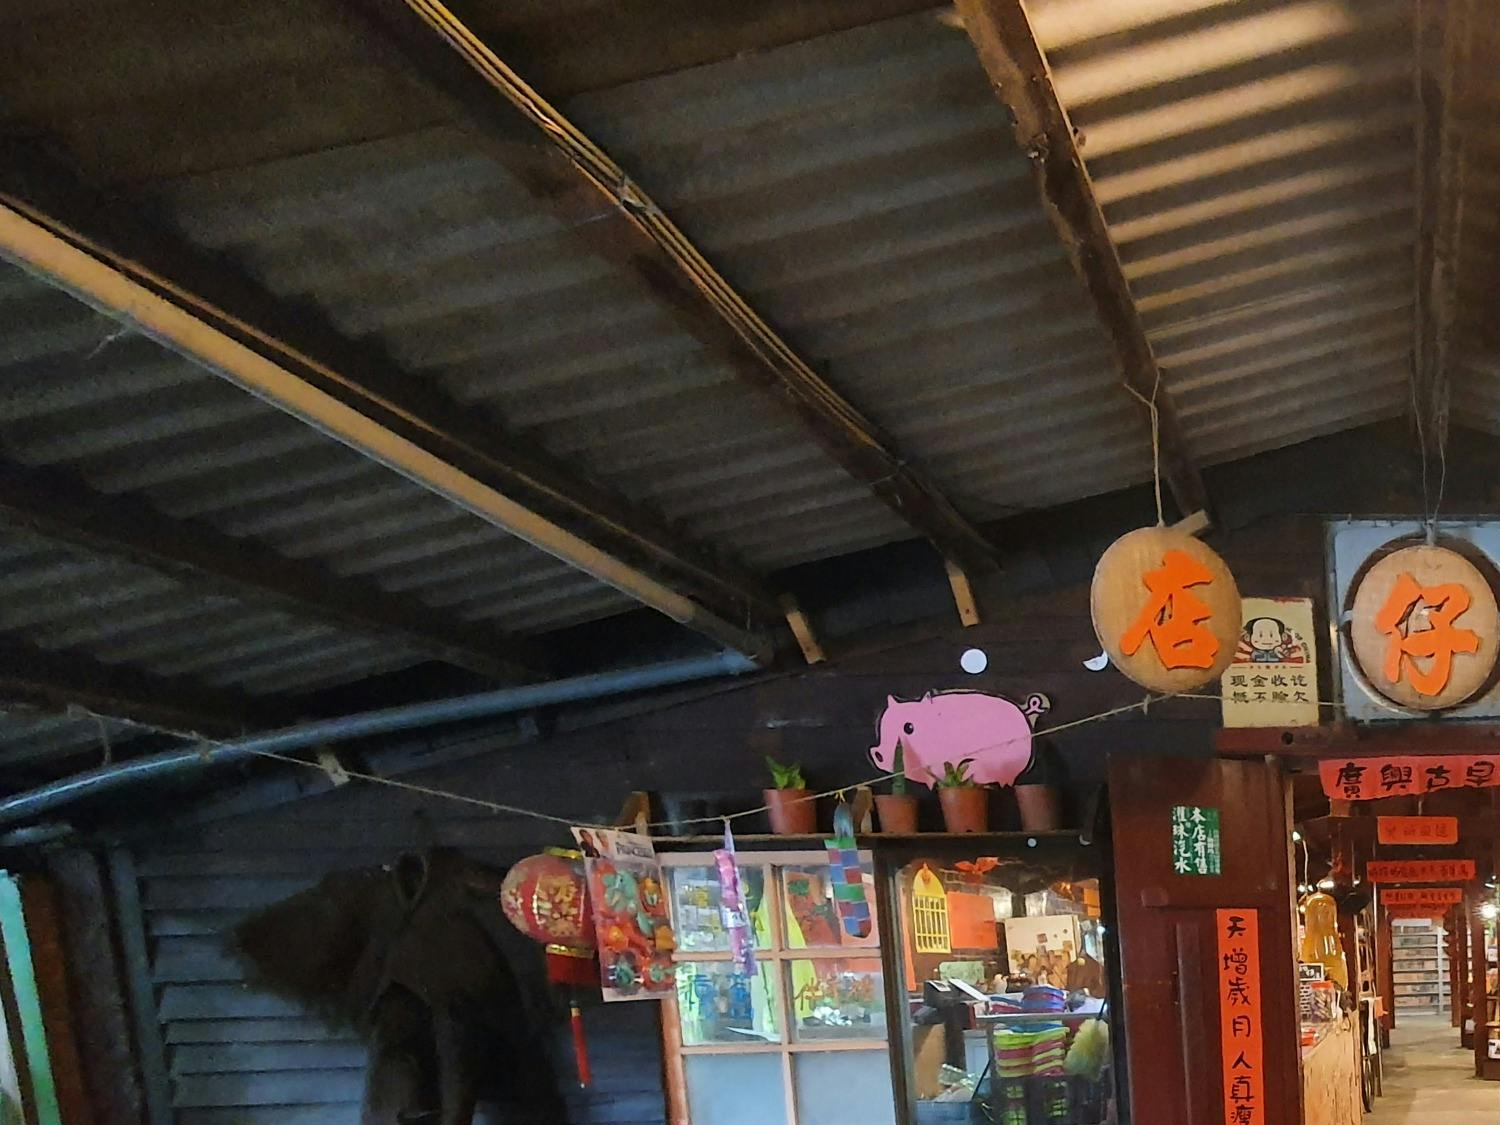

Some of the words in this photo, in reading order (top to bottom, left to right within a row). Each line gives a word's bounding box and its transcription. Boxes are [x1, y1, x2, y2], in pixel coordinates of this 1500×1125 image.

[1120, 550, 1221, 671] 店
[1375, 570, 1480, 697] 仔
[1230, 674, 1308, 688] 现金收讫
